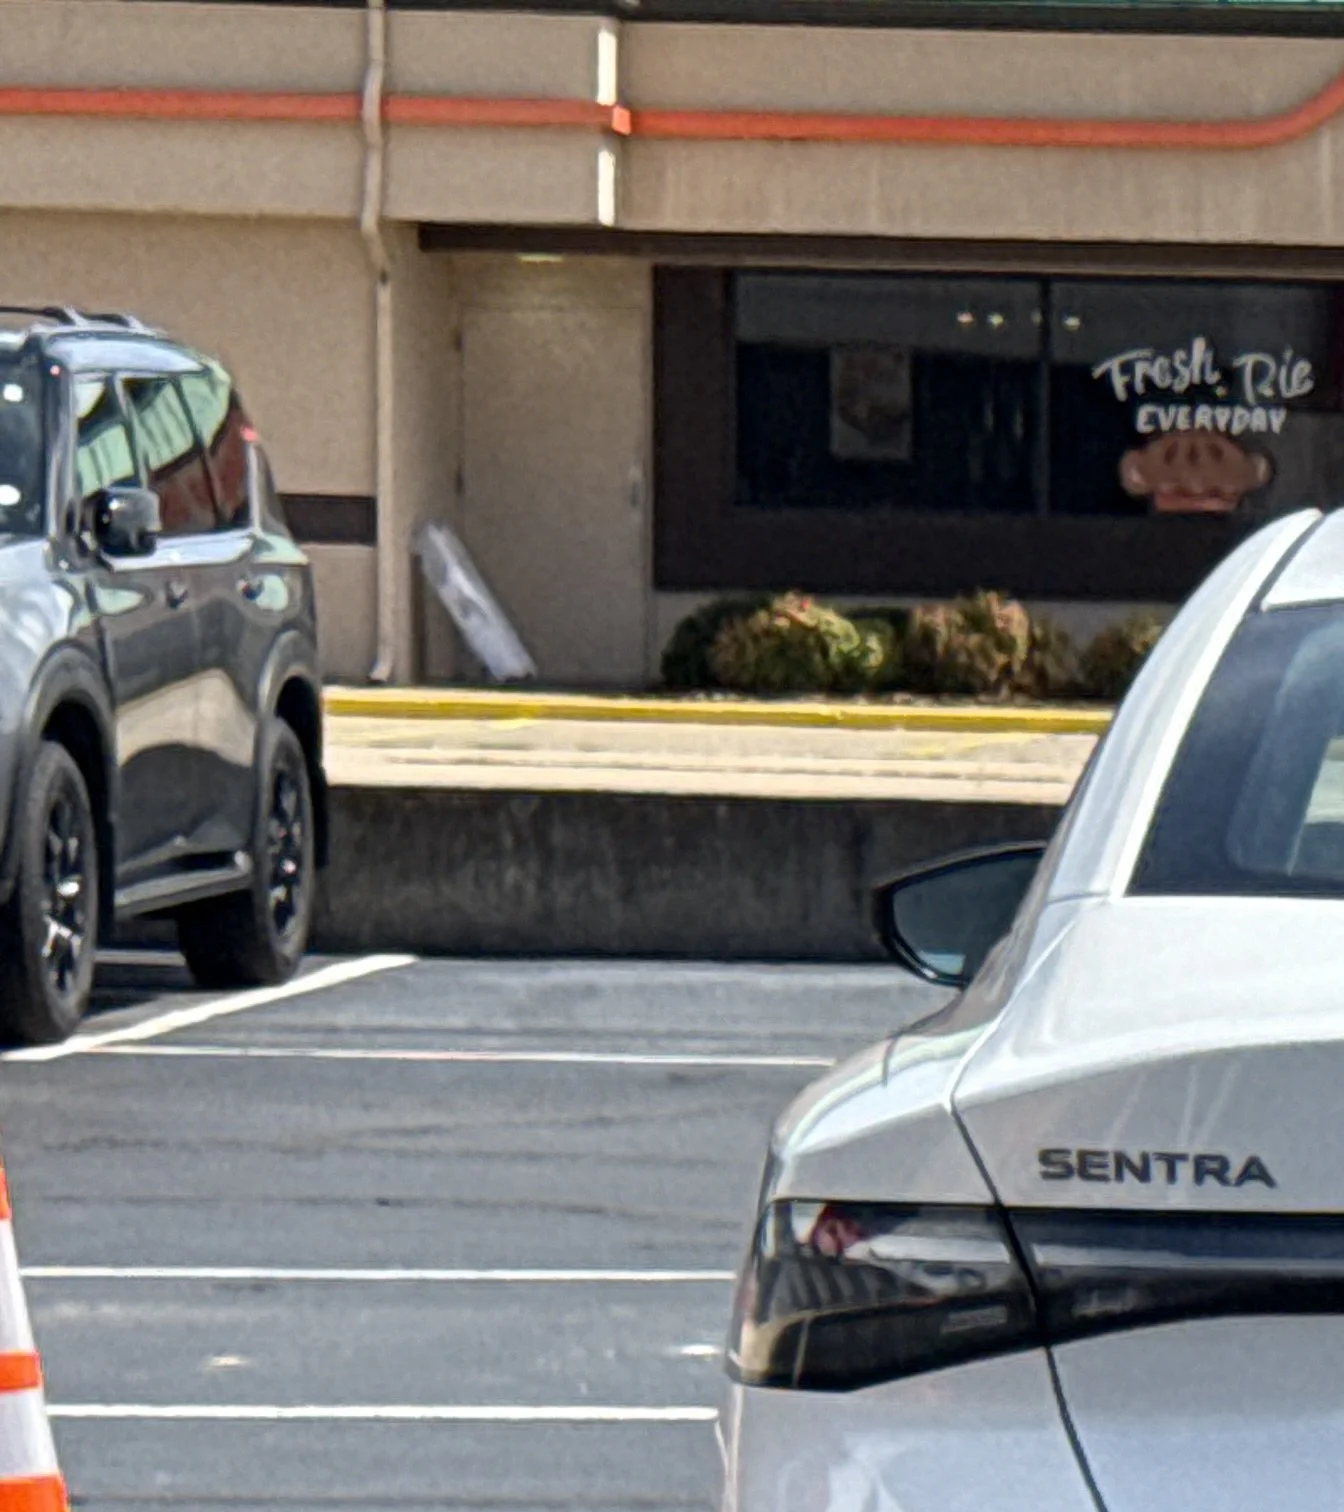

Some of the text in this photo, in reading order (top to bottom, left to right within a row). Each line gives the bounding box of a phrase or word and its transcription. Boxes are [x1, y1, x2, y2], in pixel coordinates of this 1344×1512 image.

[1092, 337, 1315, 405] Fresh Pie
[1136, 403, 1287, 434] EVERYDAY
[1038, 1148, 1277, 1189] SENTRA
